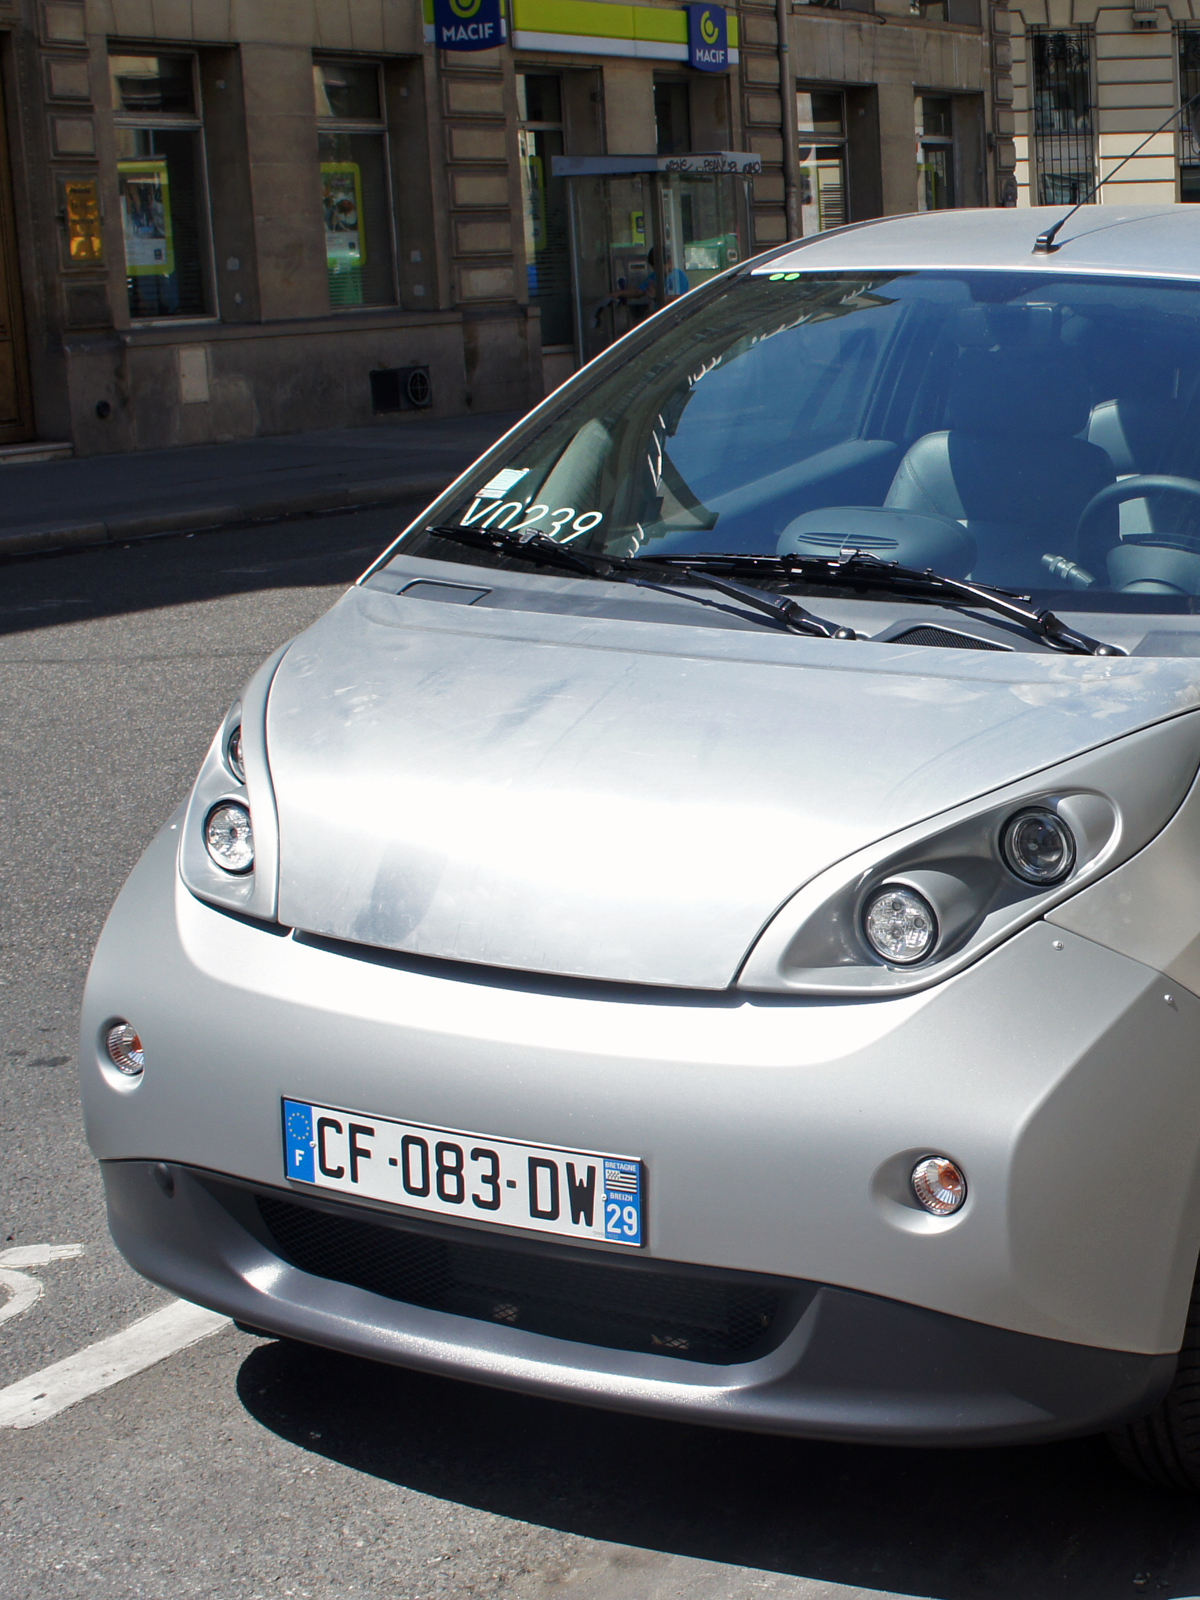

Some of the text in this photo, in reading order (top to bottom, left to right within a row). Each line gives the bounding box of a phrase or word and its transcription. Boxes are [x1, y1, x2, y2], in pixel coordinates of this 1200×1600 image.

[442, 22, 494, 42] MACIF
[696, 49, 725, 64] MACIF
[295, 1149, 305, 1166] F
[605, 1161, 637, 1172] BRETAGNE
[610, 1192, 633, 1202] BREIZH
[606, 1203, 638, 1236] 29
